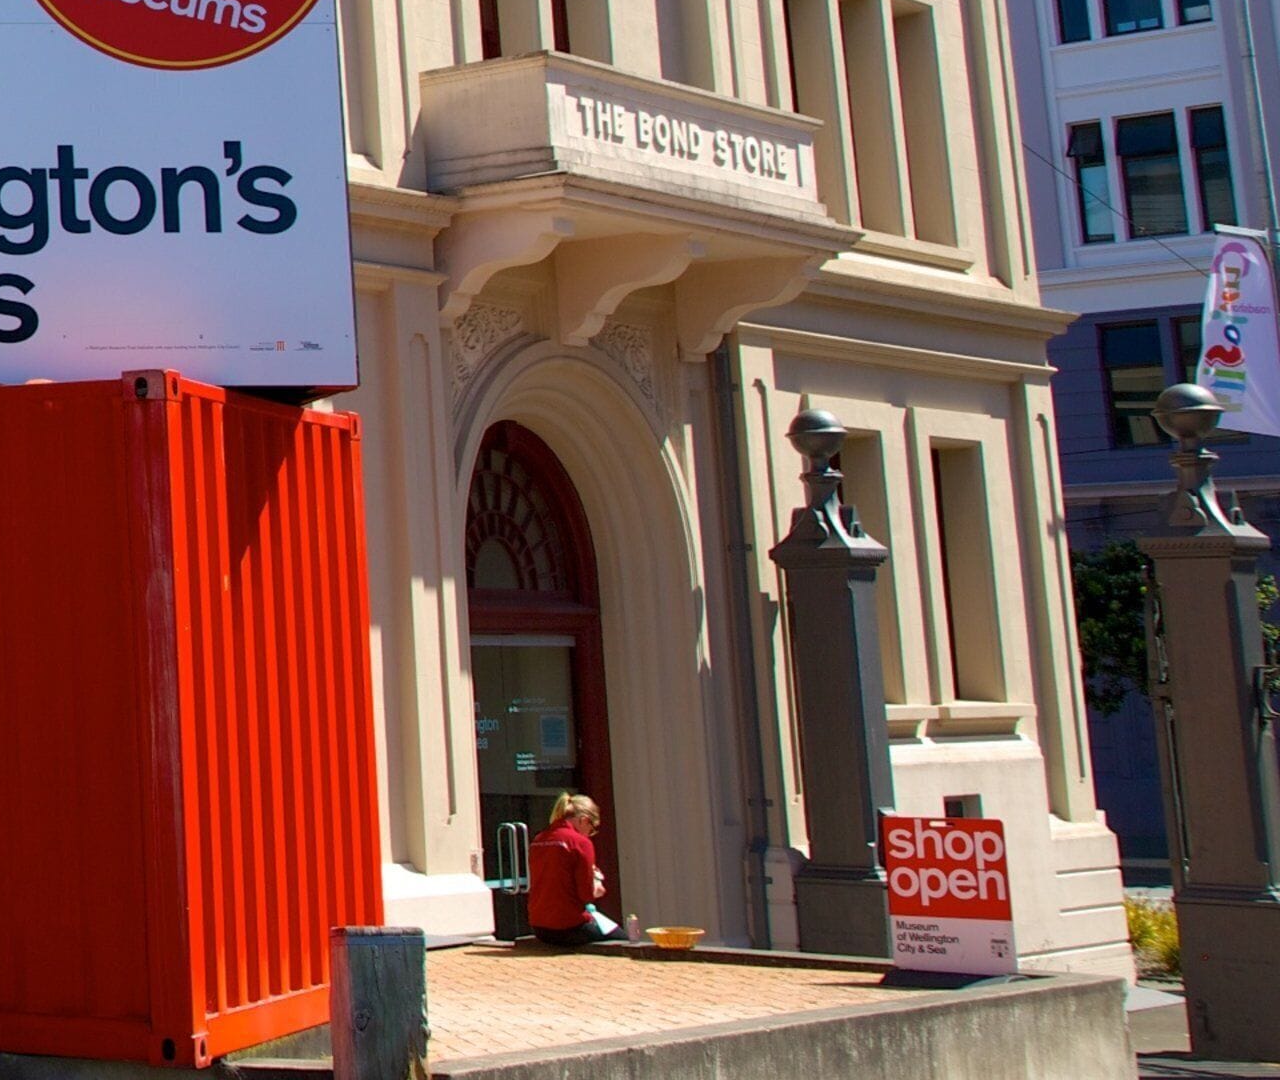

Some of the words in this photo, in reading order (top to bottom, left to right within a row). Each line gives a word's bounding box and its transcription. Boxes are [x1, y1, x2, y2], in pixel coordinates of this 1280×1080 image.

[580, 96, 626, 143] THE
[637, 110, 704, 159] BOND
[713, 129, 788, 180] STORE
[888, 819, 1004, 870] shop
[890, 866, 1007, 907] open
[896, 920, 939, 932] Museum
[897, 931, 908, 941] of
[908, 932, 960, 945] Wellington
[897, 943, 916, 954] City
[918, 944, 926, 954] &
[927, 944, 947, 955] Sea
